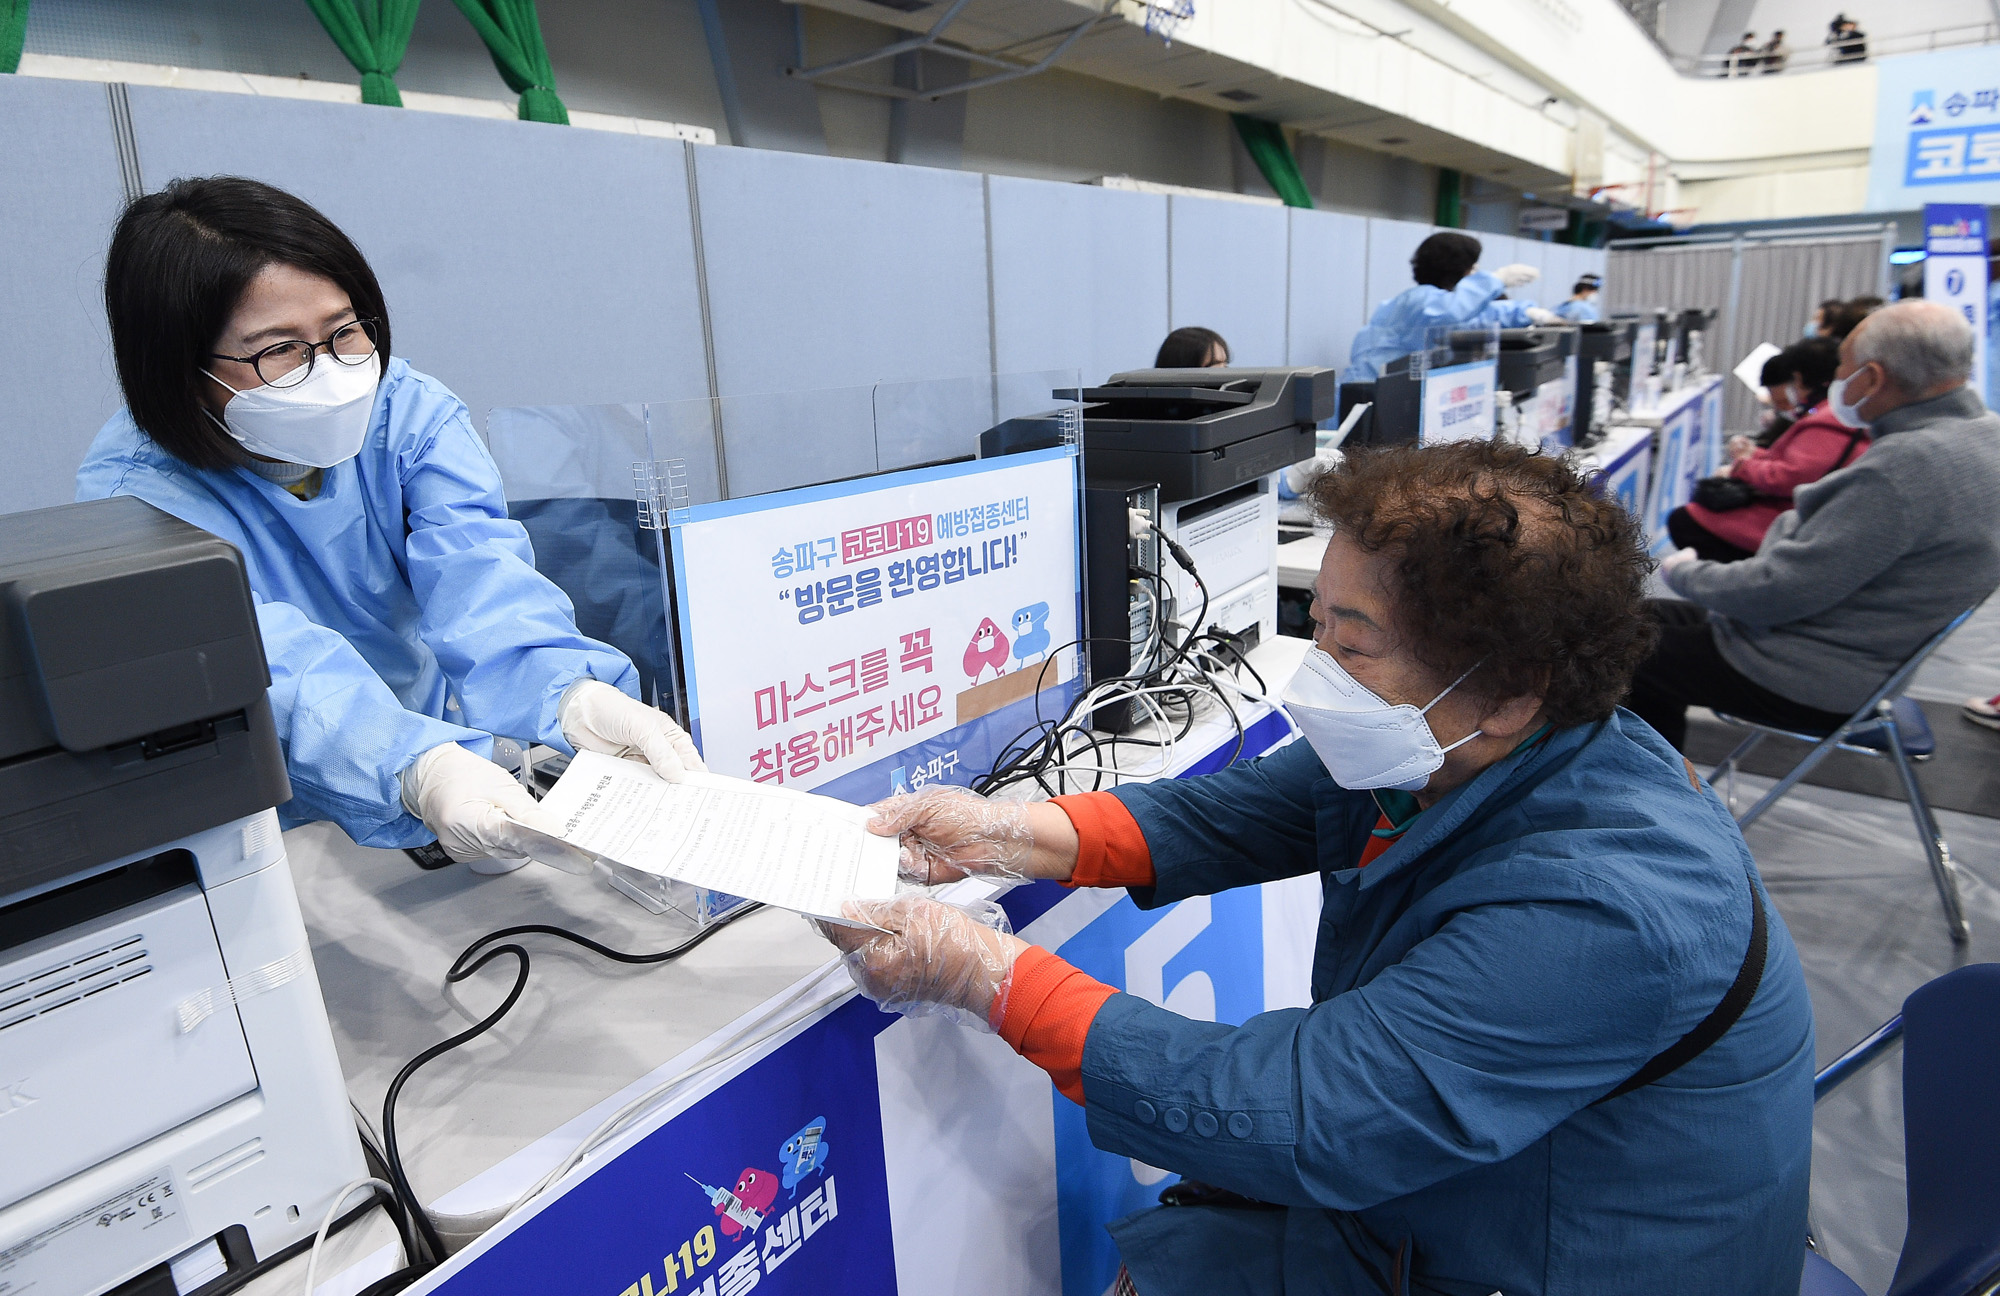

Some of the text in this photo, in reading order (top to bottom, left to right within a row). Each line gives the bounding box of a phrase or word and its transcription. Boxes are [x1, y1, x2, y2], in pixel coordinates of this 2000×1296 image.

[771, 496, 1030, 579] 송파구 코로나19 예방접종센터
[754, 627, 934, 731] 마스크를 꼭
[749, 684, 944, 786] 착용해주세요
[909, 749, 960, 792] 송파구
